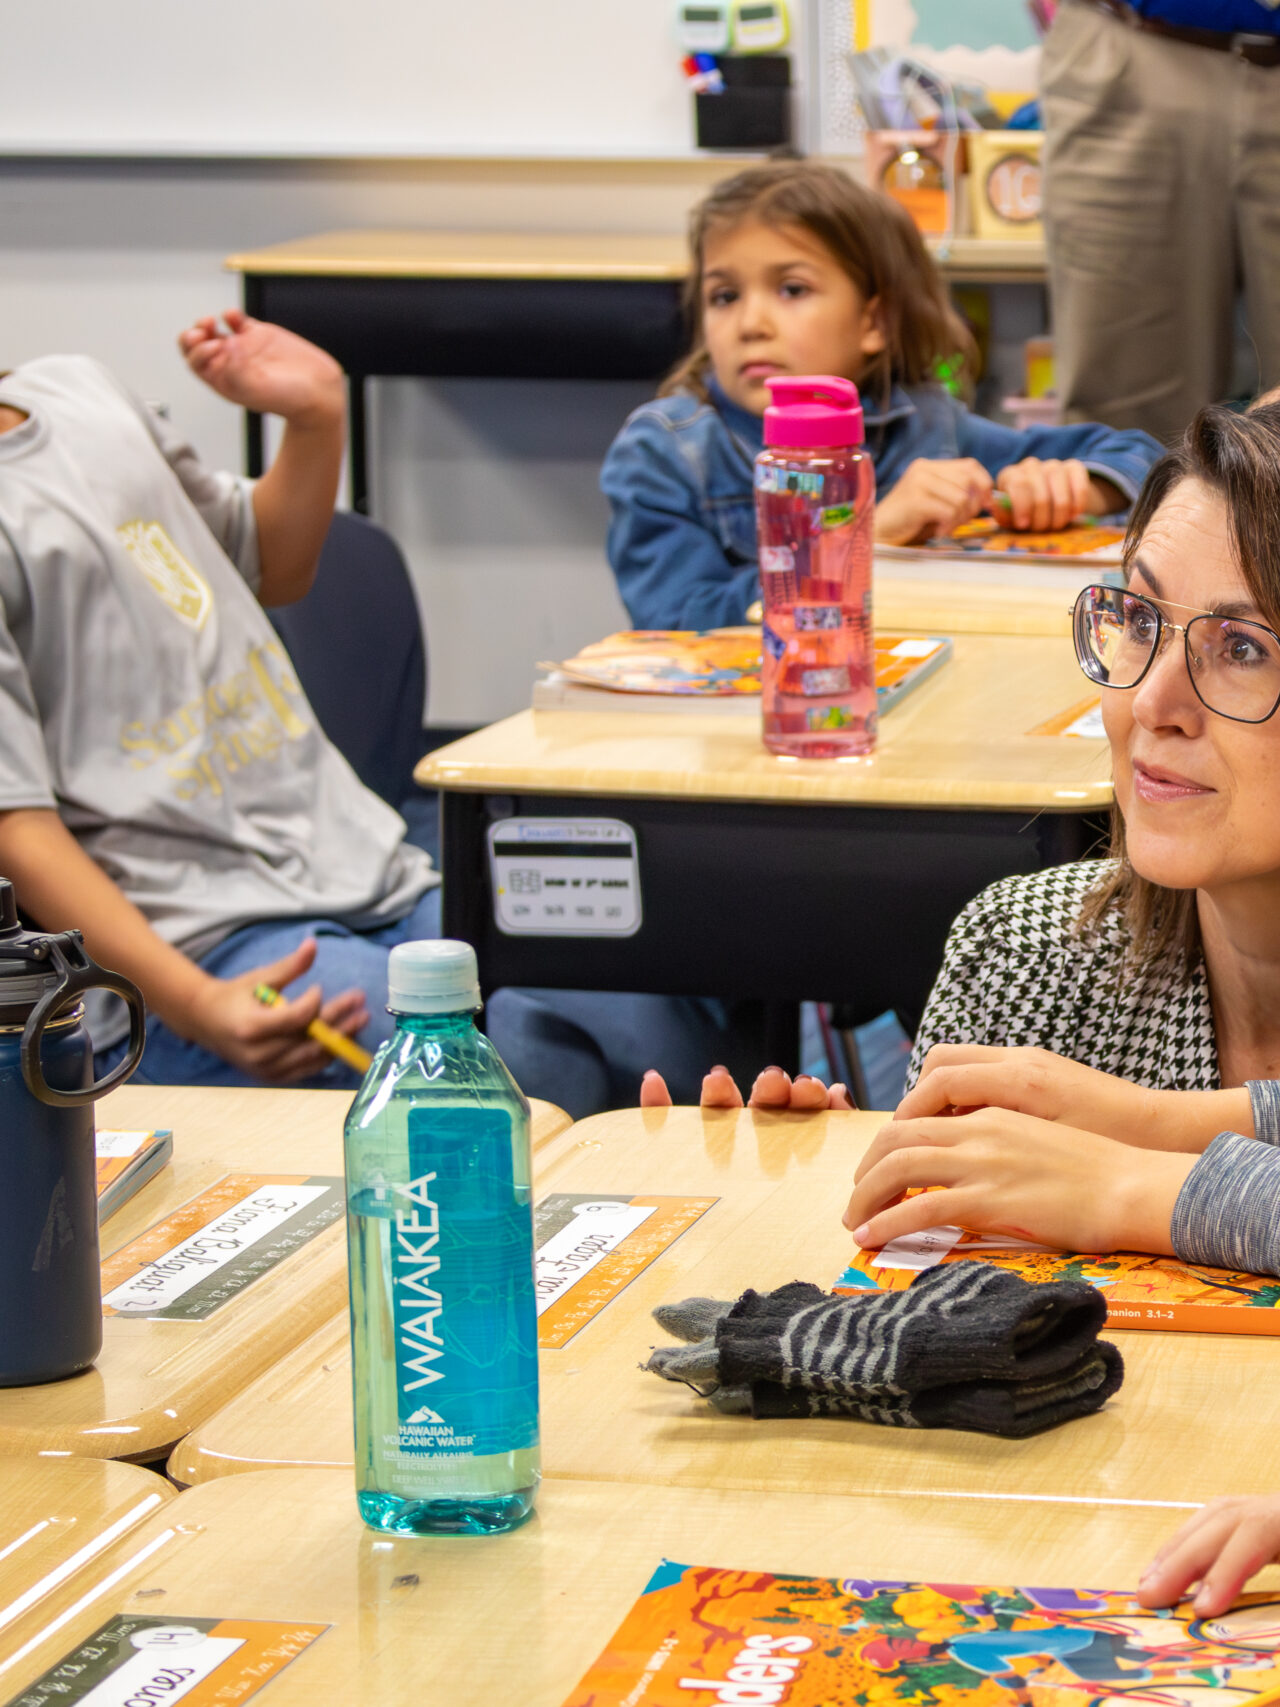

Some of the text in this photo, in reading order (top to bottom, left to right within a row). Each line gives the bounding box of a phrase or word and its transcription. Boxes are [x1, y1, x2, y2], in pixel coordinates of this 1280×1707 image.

[399, 1426, 454, 1436] HAWAIIAN
[383, 1436, 474, 1447] VOLCANIC WATER
[147, 1632, 194, 1645] 14
[679, 1634, 814, 1707] ders
